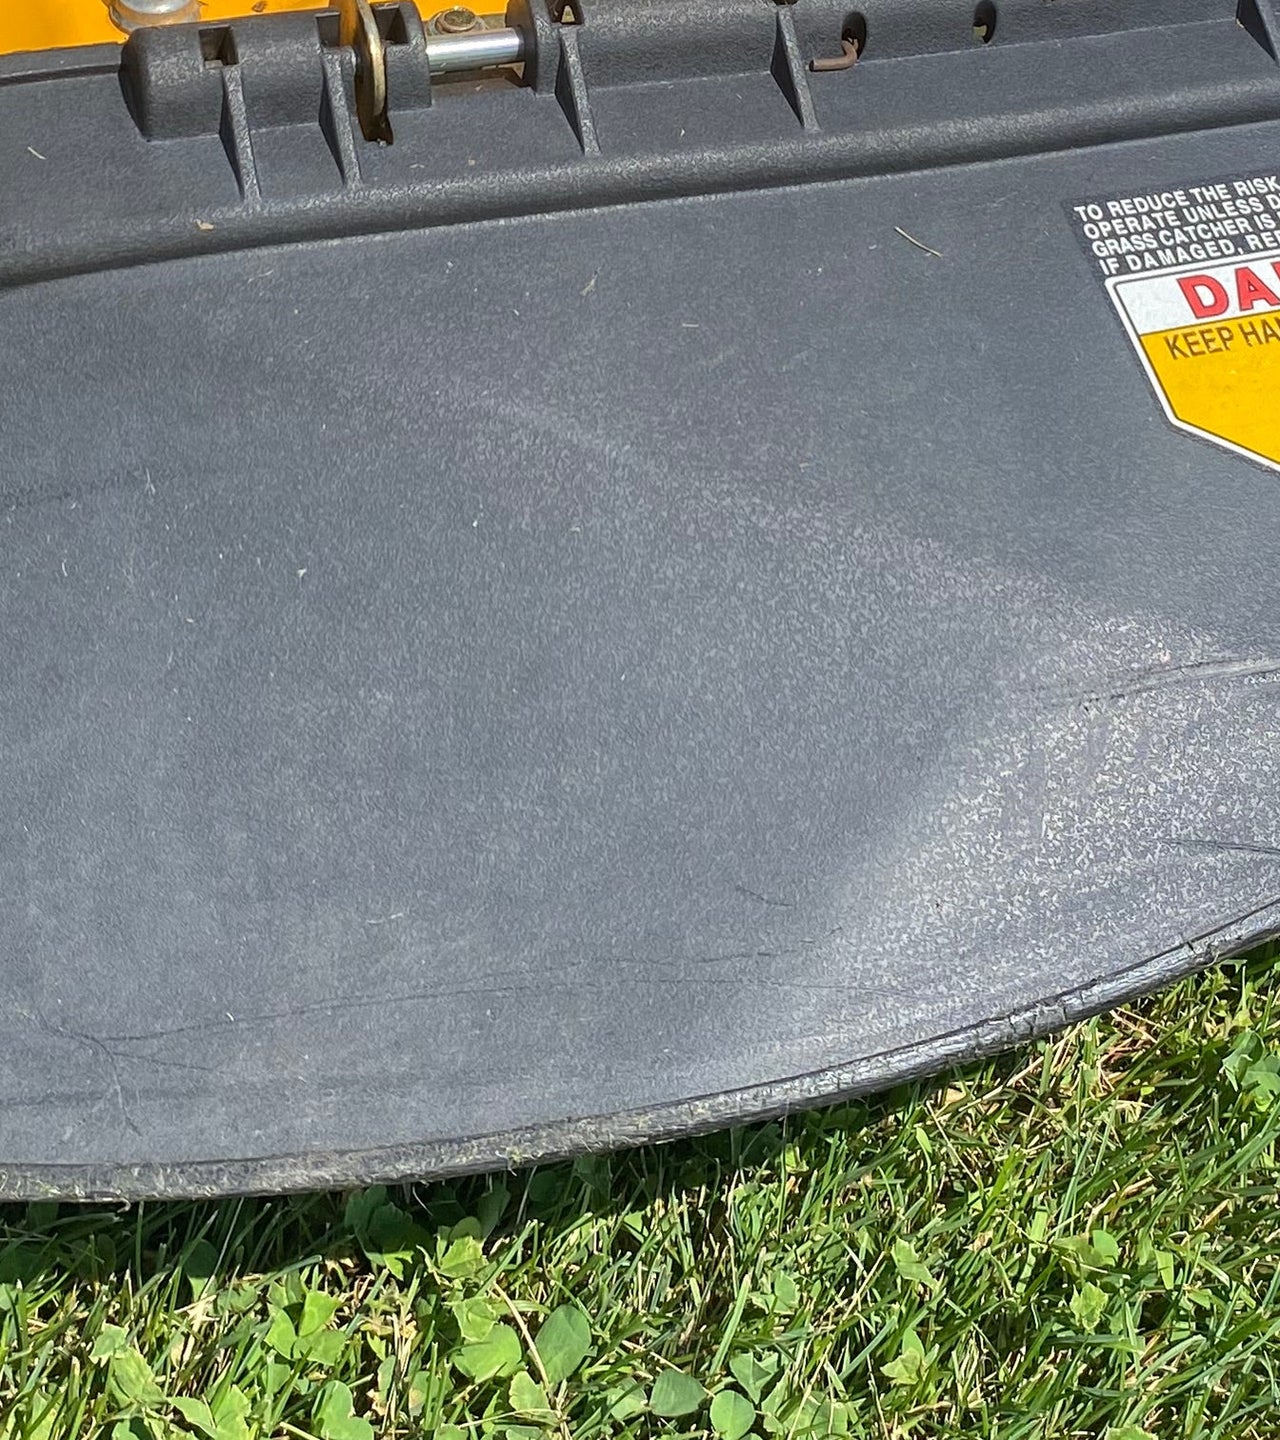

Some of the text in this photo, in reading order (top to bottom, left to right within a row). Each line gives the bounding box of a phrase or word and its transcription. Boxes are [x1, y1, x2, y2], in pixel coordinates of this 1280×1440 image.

[1074, 204, 1104, 222] TO
[1106, 189, 1190, 217] REDUCE
[1189, 184, 1232, 204] THE
[1083, 211, 1181, 240] OPERATE
[1183, 197, 1264, 223] UNLESS
[1092, 233, 1158, 257] GRASS
[1158, 218, 1251, 246] CATCHER
[1253, 213, 1276, 230] IS
[1098, 259, 1120, 275] IF
[1126, 239, 1244, 271] DAMAGED,
[1162, 326, 1235, 361] KEEP
